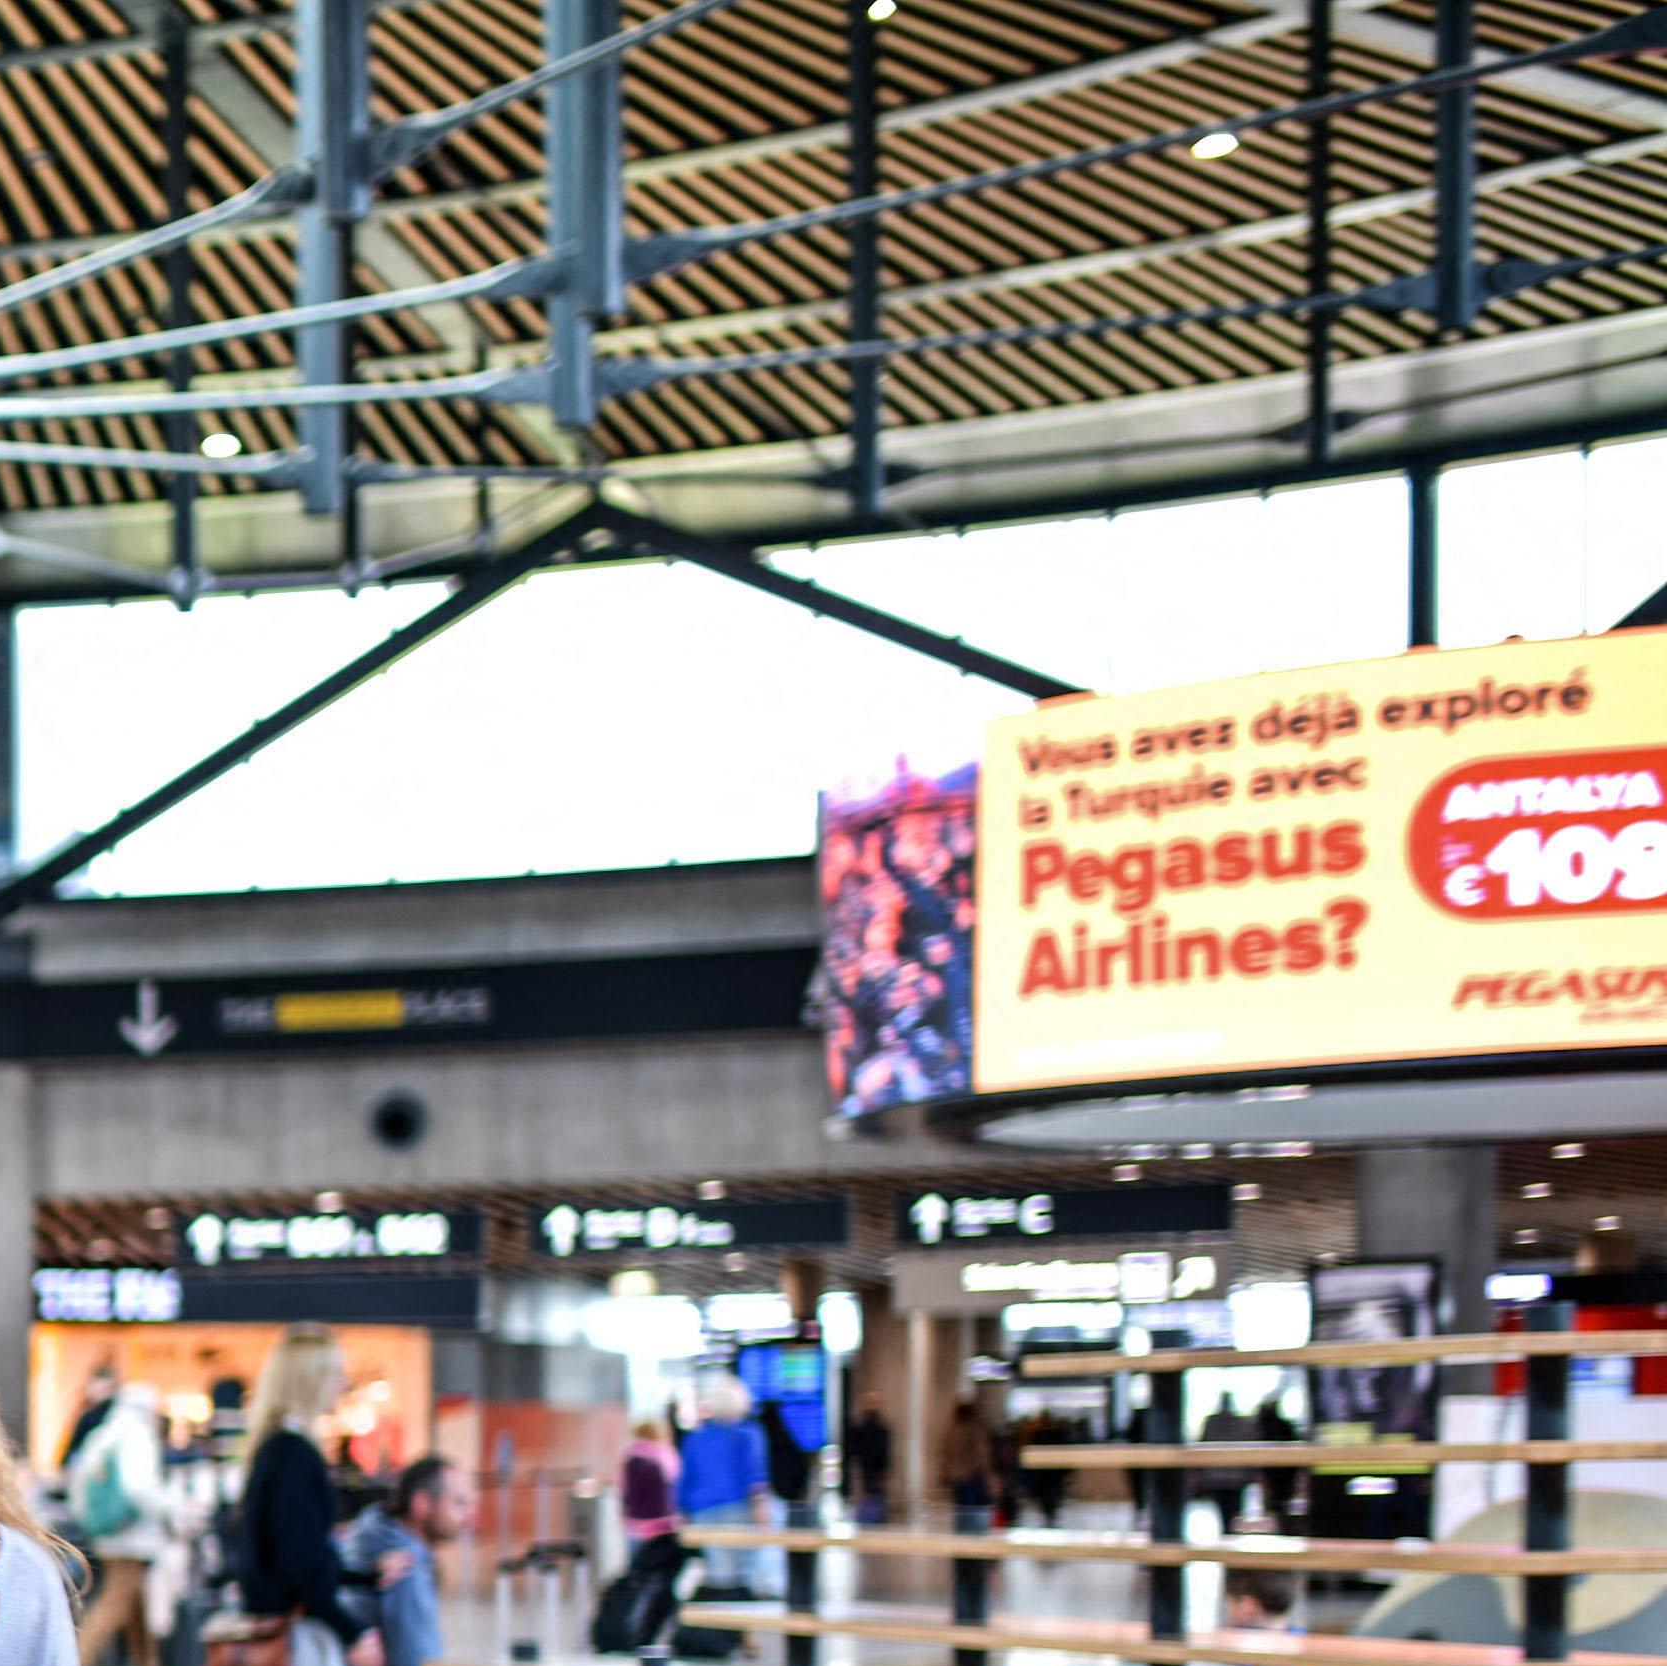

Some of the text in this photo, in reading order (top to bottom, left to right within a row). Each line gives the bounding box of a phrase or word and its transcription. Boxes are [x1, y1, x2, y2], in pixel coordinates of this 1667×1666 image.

[1020, 665, 1593, 776] Vous avez déjà exploré
[1018, 756, 1368, 831] la Turquie avec
[1441, 770, 1663, 824] ANTALYA
[1020, 819, 1369, 918] Pegasus
[1017, 895, 1371, 1000] Airlines?
